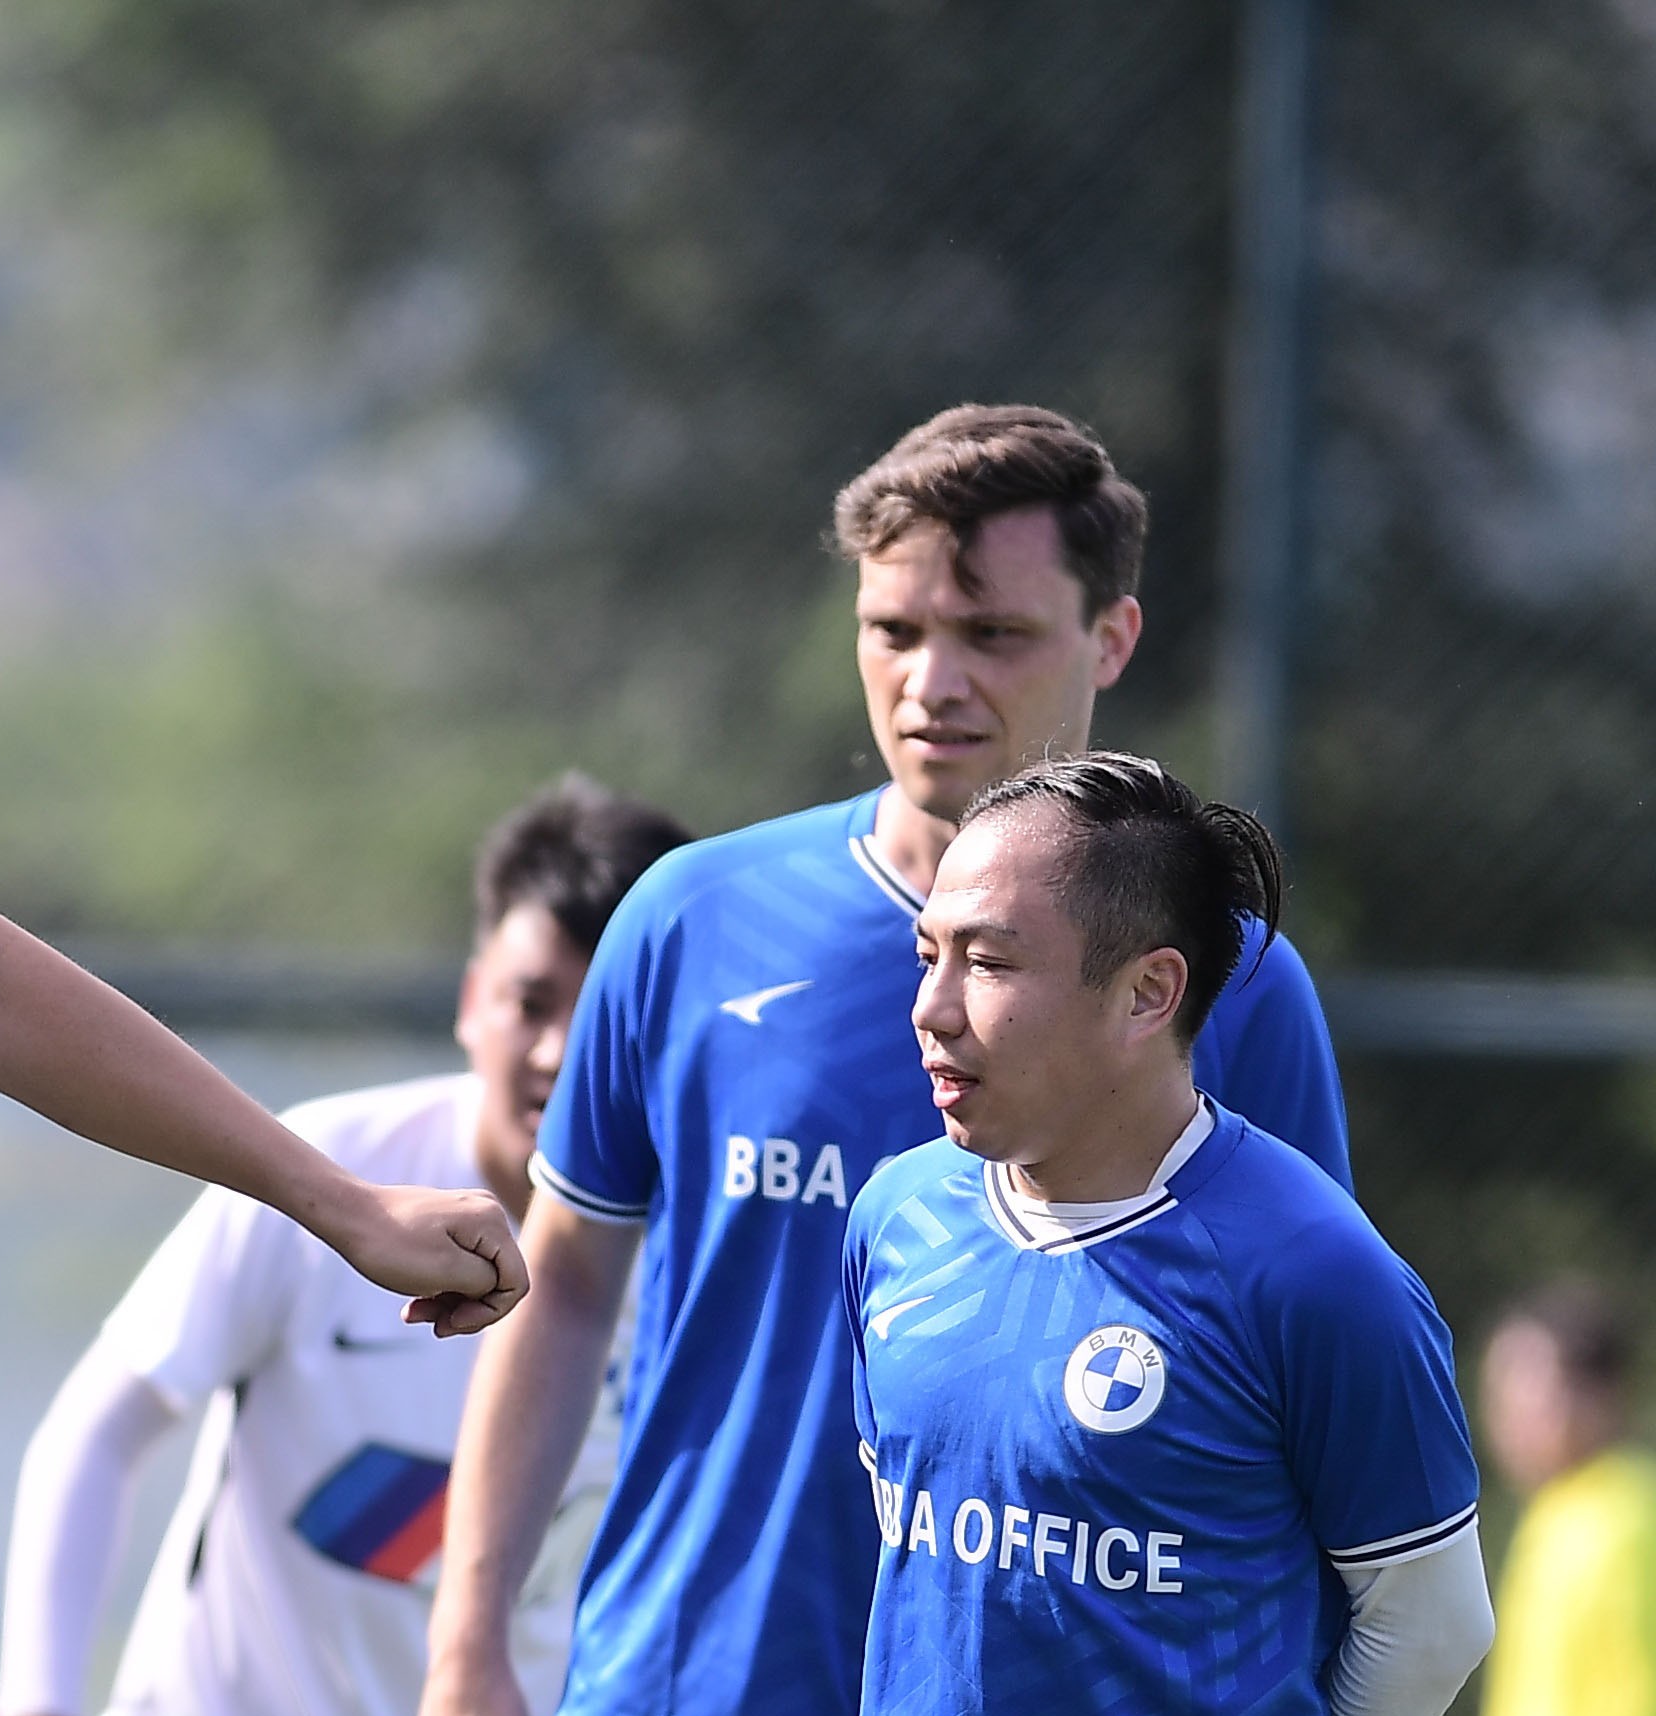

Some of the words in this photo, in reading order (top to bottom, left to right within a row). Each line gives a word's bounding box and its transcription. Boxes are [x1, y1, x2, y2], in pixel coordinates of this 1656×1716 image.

[723, 1134, 848, 1209] BBA
[1088, 1330, 1161, 1368] BMW
[952, 1497, 1185, 1594] OFFICE
